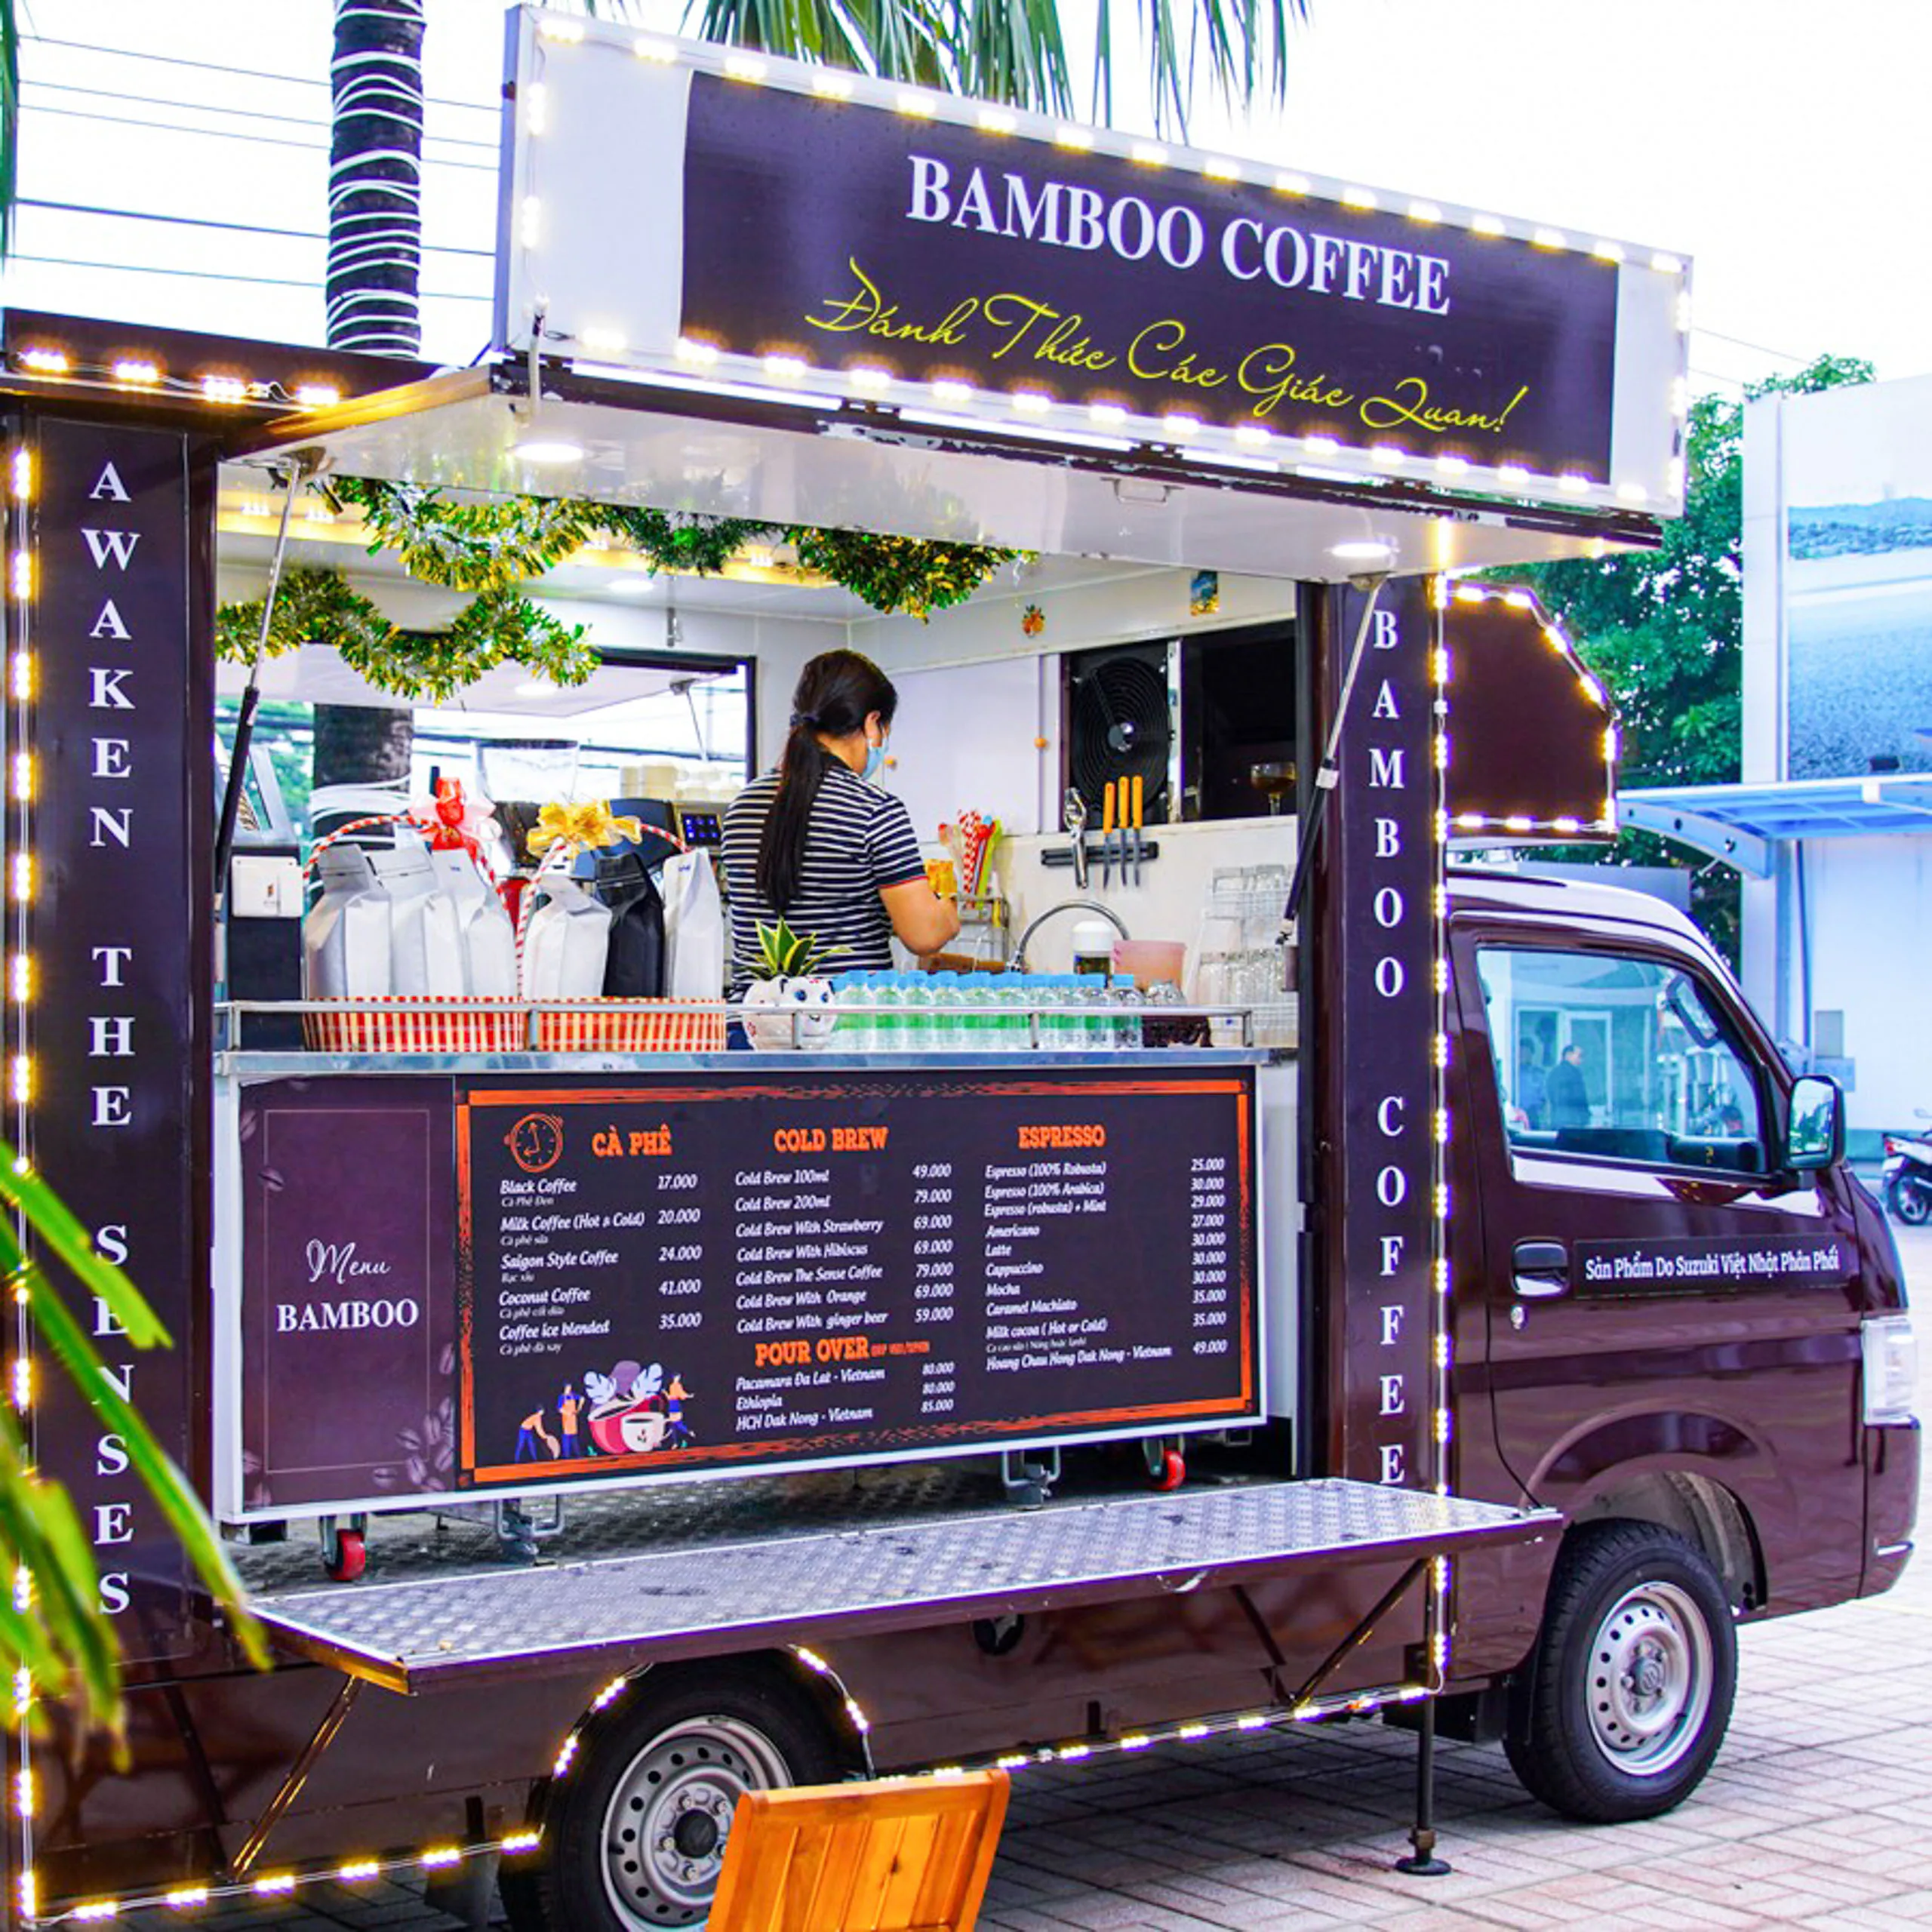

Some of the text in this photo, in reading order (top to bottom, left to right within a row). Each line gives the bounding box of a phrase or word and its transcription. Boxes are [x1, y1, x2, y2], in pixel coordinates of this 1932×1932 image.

[906, 154, 1451, 315] BAMBOO COFFEE
[805, 255, 1530, 432] Đánh Thức Các Giác Quan!
[82, 461, 141, 849] AWAKEN
[88, 946, 136, 1126] THE
[1369, 610, 1406, 1484] BAMBOO COFFEE
[592, 1123, 672, 1157] CÀ PHÊ
[774, 1127, 889, 1152] COLD BREW
[1018, 1124, 1106, 1149] ESPRESSO
[735, 1164, 952, 1186] Cold Brew 100ml 49.000
[985, 1164, 1026, 1180] Espresso
[1028, 1162, 1061, 1177] (100%
[500, 1174, 698, 1195] Black Coffee 17.000
[985, 1184, 1026, 1200] Espresso
[1028, 1182, 1061, 1198] (100%
[735, 1189, 952, 1211] Cold Brew 200ml 79.000
[985, 1203, 1026, 1219] Espresso
[500, 1217, 528, 1232] Milk
[532, 1215, 571, 1232] Coffee
[573, 1213, 601, 1229] (Hot
[613, 1211, 645, 1227] Cold)
[657, 1208, 701, 1224] 20.000
[736, 1214, 953, 1238] Cold Brew With Strawberry 69.000
[985, 1223, 1040, 1238] Americano
[306, 1238, 391, 1284] Menu
[500, 1244, 703, 1271] Saigon Style Coffee 24.000
[737, 1239, 954, 1262] Cold Brew With Hibiscus 69.000
[985, 1244, 1012, 1257] Latte
[736, 1262, 954, 1286] Cold Brew The Sense Coffee 79.000
[985, 1261, 1044, 1278] Cappuccino
[1586, 1255, 1611, 1280] Sản
[1614, 1251, 1654, 1278] Phẩm
[1657, 1257, 1673, 1277] Do
[1675, 1254, 1720, 1276] Suzuki
[1721, 1252, 1746, 1280] Việt
[1748, 1251, 1778, 1278] Nhật
[500, 1278, 702, 1306] Coconut Coffee 41.000
[736, 1283, 954, 1309] Cold Brew With Orange 69.000
[986, 1284, 1020, 1297] Mocha
[276, 1299, 419, 1333] BAMBOO
[737, 1306, 954, 1334] Cold Brew With ginger beer 59.000
[986, 1302, 1029, 1316] Caramel
[500, 1312, 703, 1340] Coffee ice blended 35.000
[986, 1326, 1009, 1340] Milk
[755, 1340, 811, 1367] POUR
[816, 1336, 869, 1361] OVER
[1132, 1345, 1172, 1358] Vietnam
[840, 1368, 885, 1383] Vietnam
[736, 1394, 783, 1411] Ethiopia
[829, 1407, 873, 1423] Vietnam
